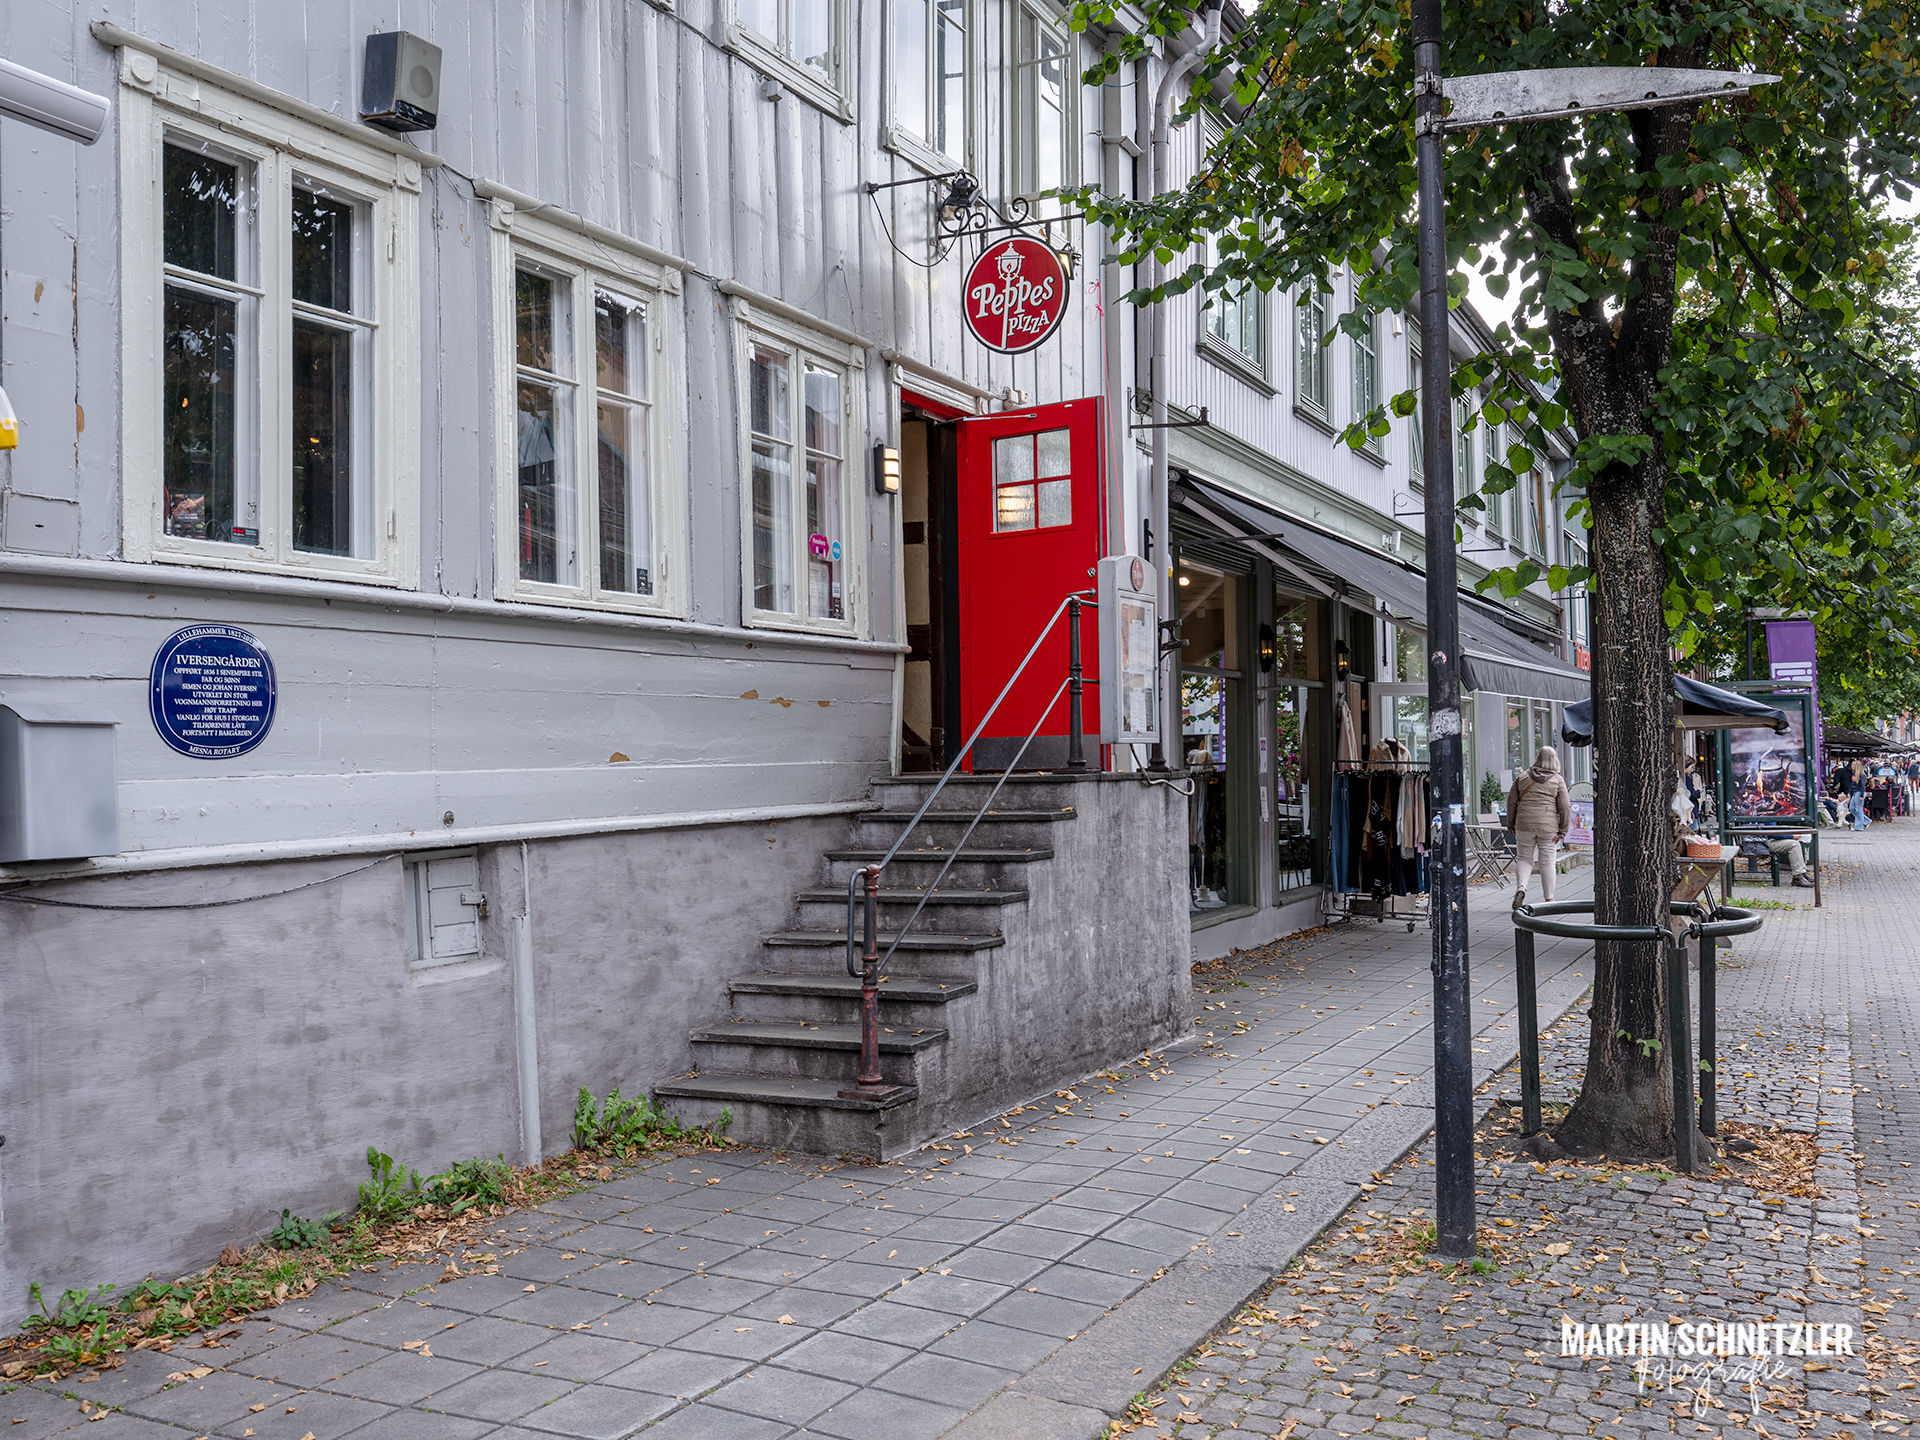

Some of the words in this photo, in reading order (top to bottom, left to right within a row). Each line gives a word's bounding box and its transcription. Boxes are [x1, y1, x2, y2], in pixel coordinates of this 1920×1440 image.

[972, 276, 1054, 318] Peppes
[1008, 310, 1050, 336] PIZZA
[178, 628, 226, 642] LILLEHAMMER
[176, 655, 260, 668] IVERSENGÅRDEN
[174, 698, 250, 706] VOGNMANNSFORRETNING
[189, 746, 212, 755] MESNA
[214, 747, 240, 755] ROTARY
